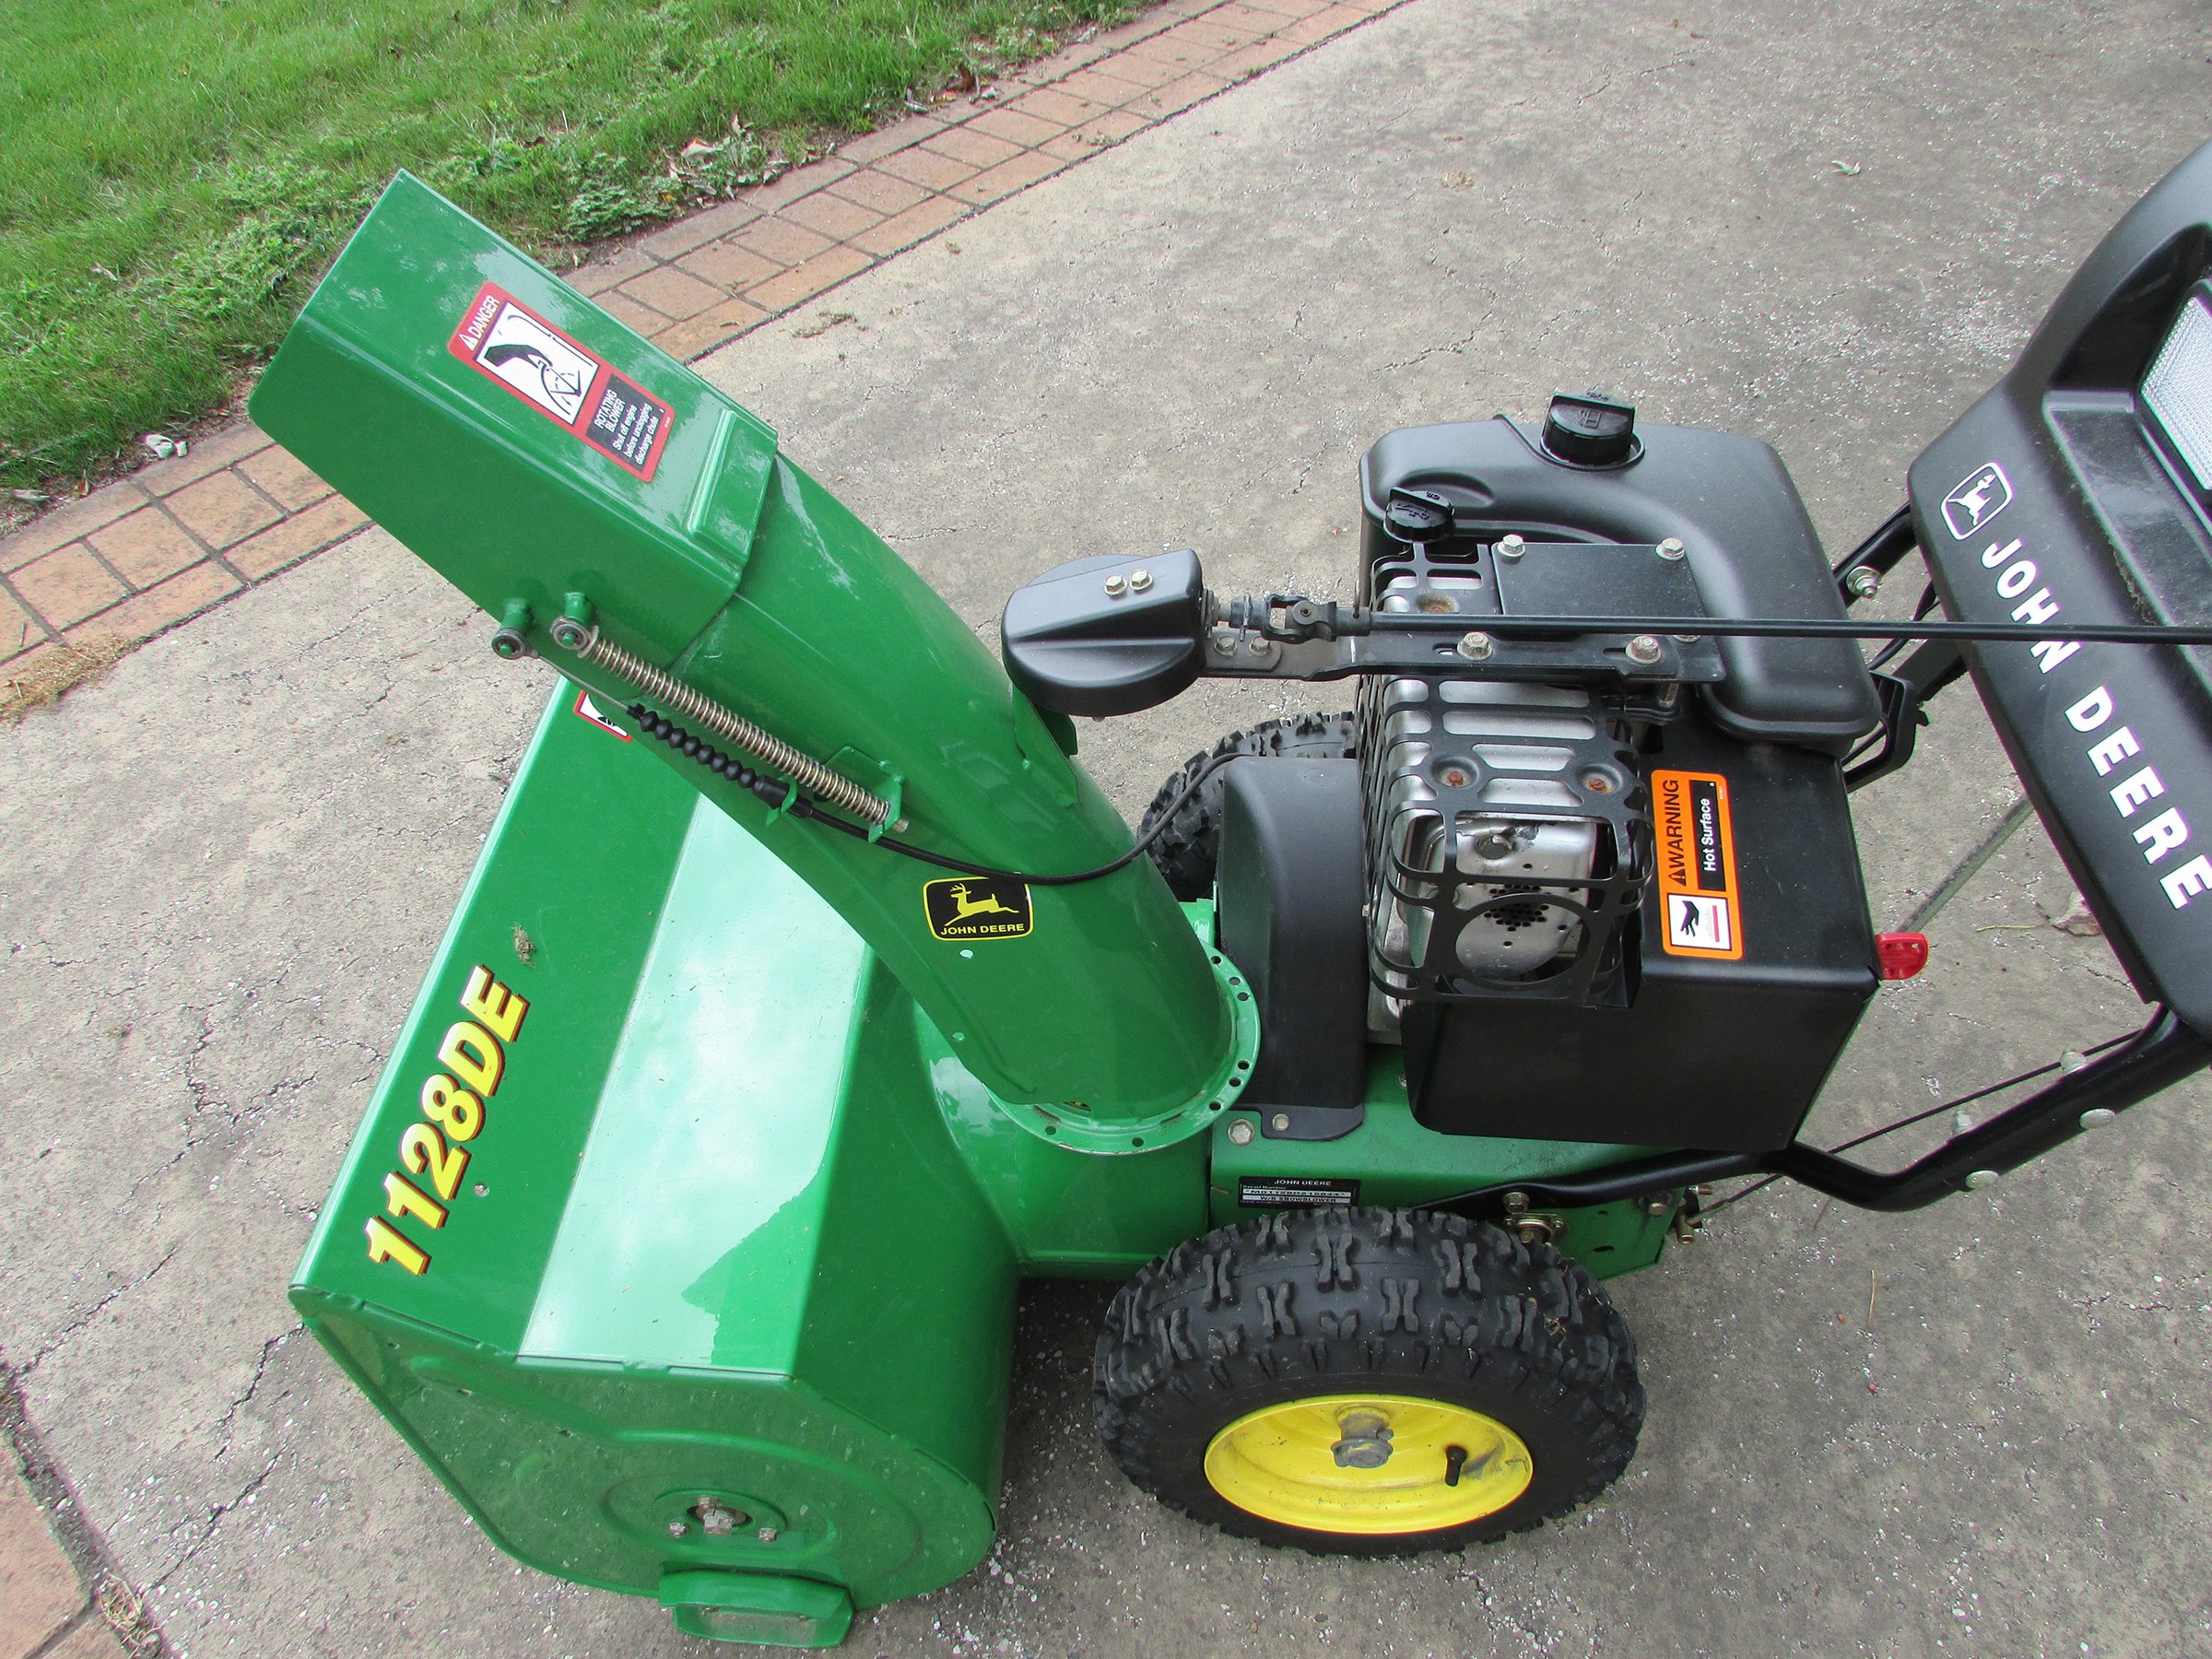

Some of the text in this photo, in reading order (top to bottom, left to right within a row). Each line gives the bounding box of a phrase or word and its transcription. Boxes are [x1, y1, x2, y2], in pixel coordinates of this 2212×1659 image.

[467, 295, 500, 338] DANGER
[594, 389, 618, 429] ROTATING
[605, 398, 626, 433] BLOWER
[612, 405, 638, 451] Shut off engine
[623, 403, 653, 458] before unclogging
[634, 416, 659, 465] discharge chute
[1981, 538, 2212, 911] JOHN DEERE
[1663, 780, 1686, 869] WARNING
[1700, 798, 1716, 872] Hot Surface
[940, 924, 1025, 935] JOHN DEERE
[364, 963, 530, 1276] 1128DE
